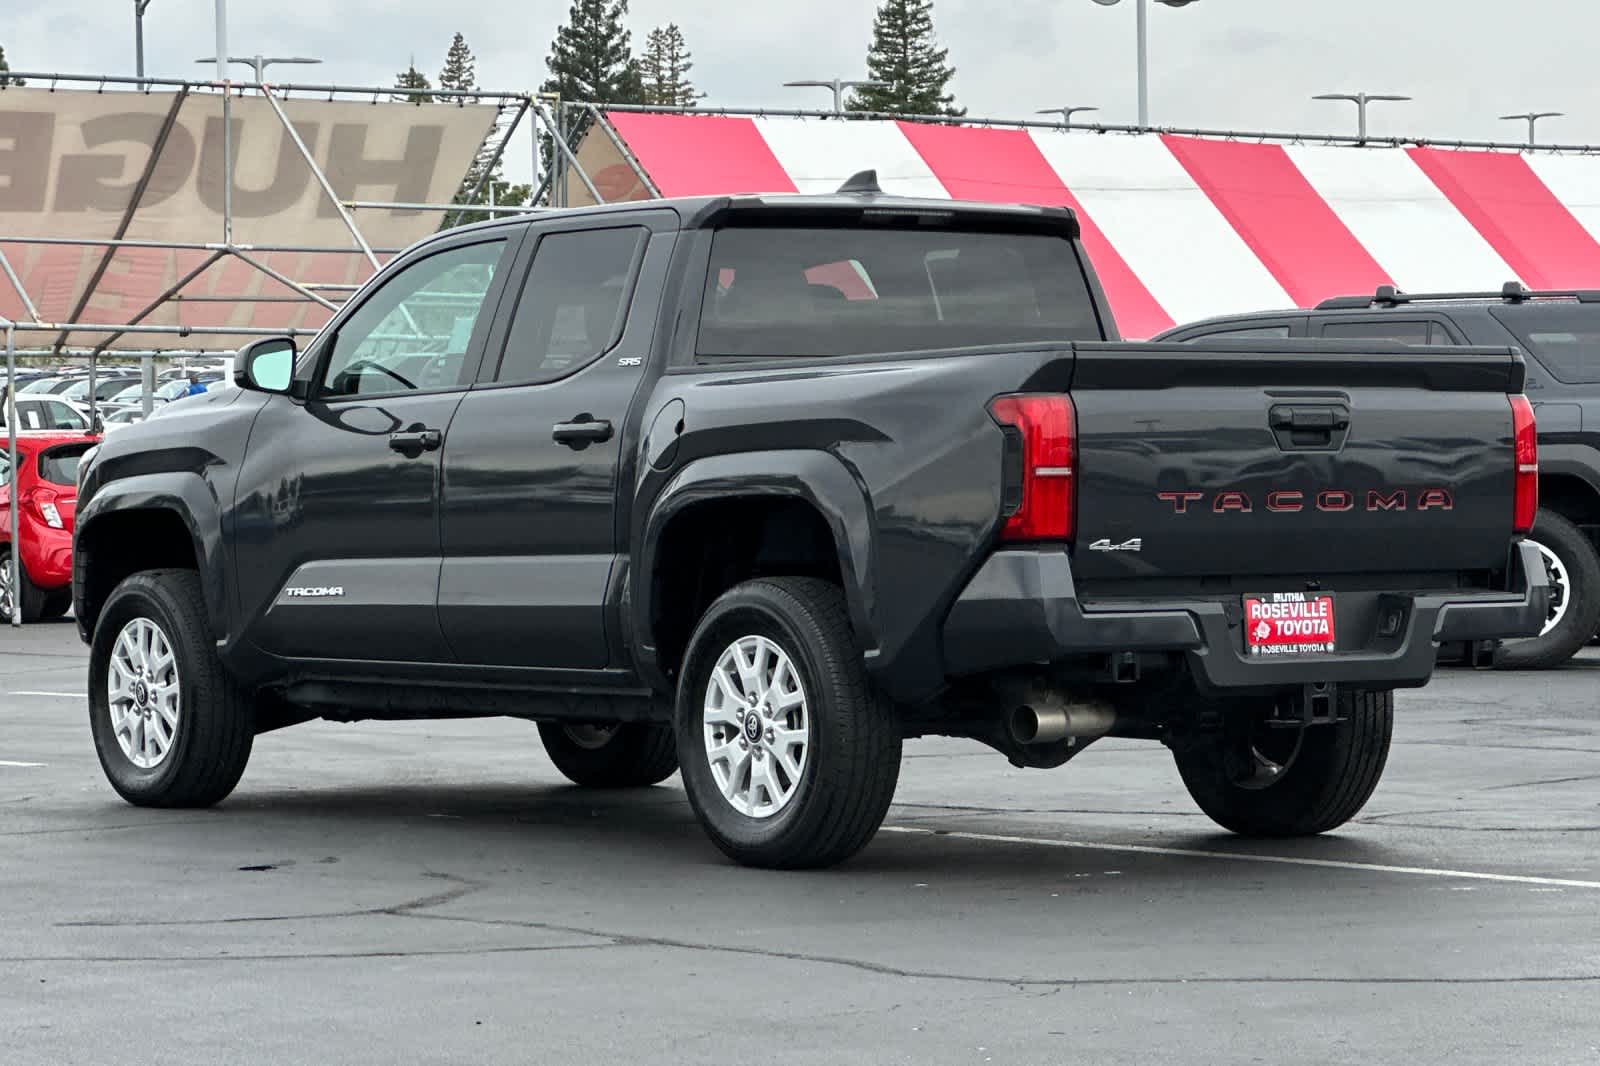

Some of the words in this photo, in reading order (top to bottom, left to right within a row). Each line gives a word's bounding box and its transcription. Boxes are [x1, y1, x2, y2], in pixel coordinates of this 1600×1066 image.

[1157, 488, 1454, 513] TACOMA
[285, 586, 344, 597] TACOMA
[1251, 602, 1328, 619] ROSEVILLE
[1275, 619, 1329, 636] TOYOTA
[1261, 644, 1298, 654] ROSEVILLE
[1299, 643, 1326, 653] TOYOTA
